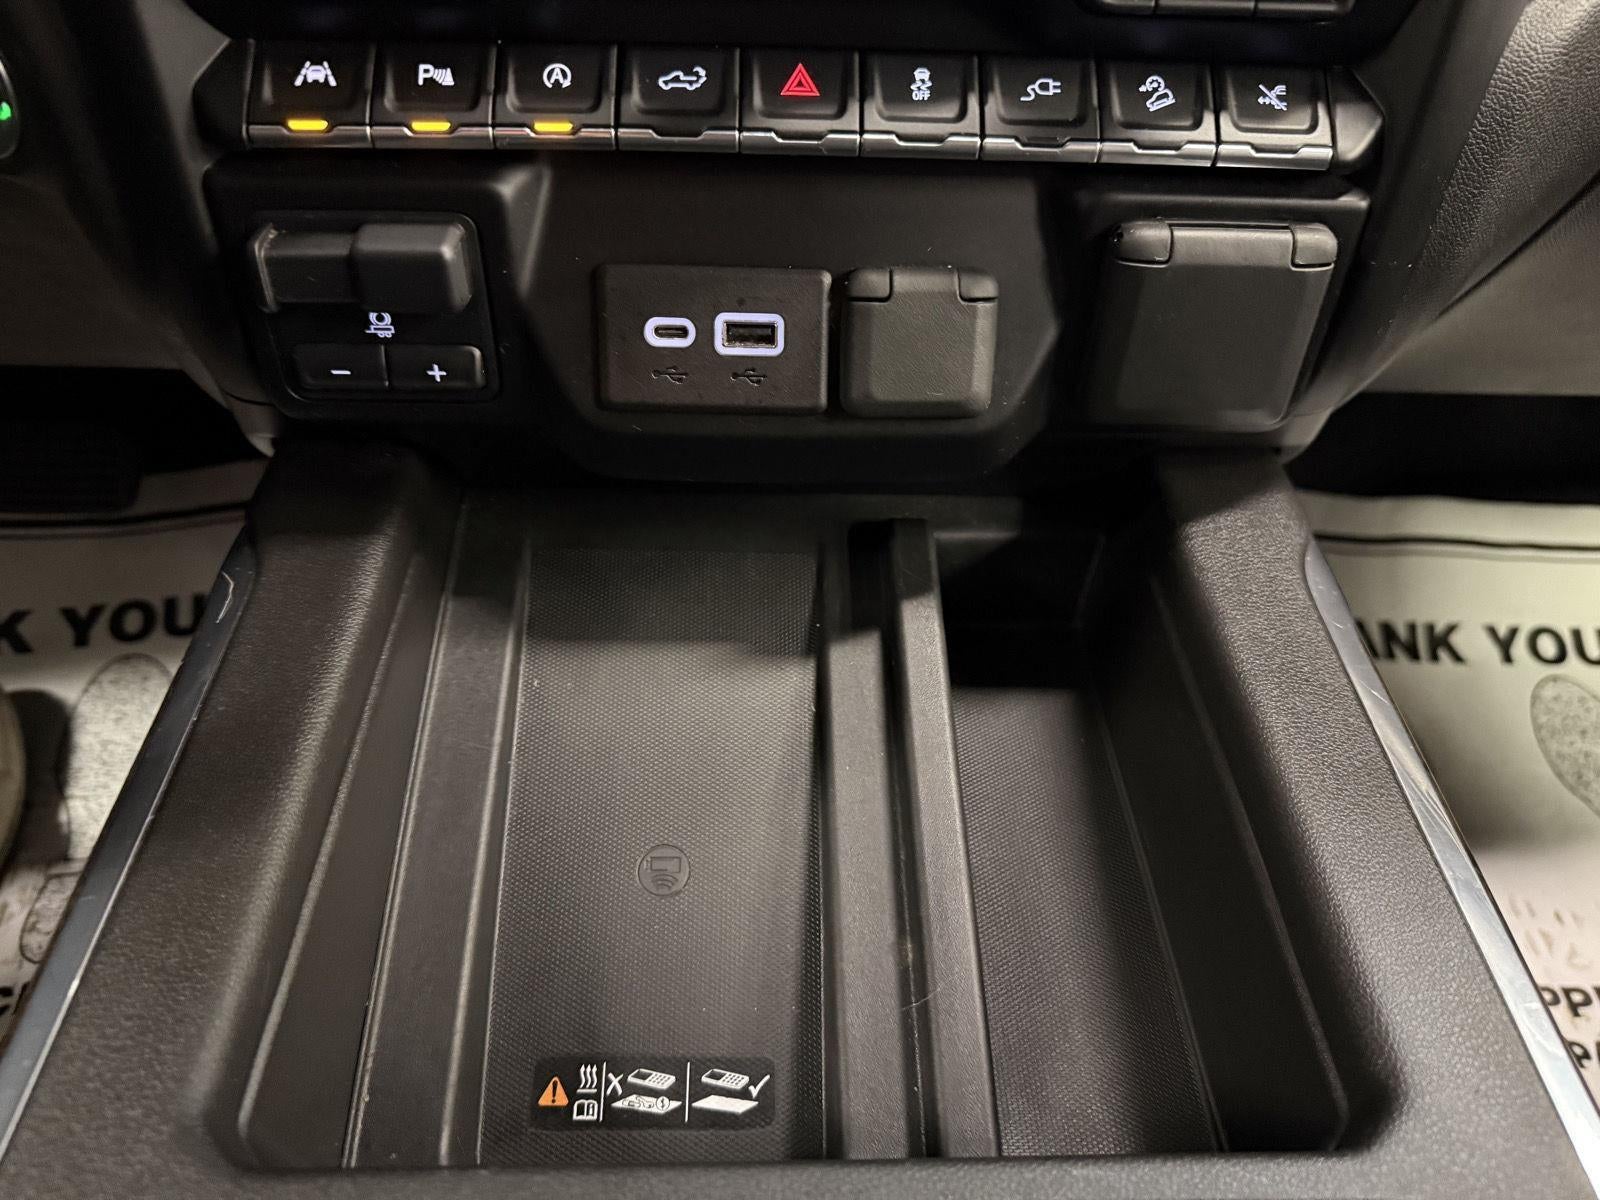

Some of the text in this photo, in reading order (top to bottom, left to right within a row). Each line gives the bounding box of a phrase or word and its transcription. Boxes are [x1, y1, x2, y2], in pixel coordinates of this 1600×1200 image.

[912, 90, 931, 101] OFF
[60, 593, 206, 647] YOU
[1485, 624, 1600, 666] YOU
